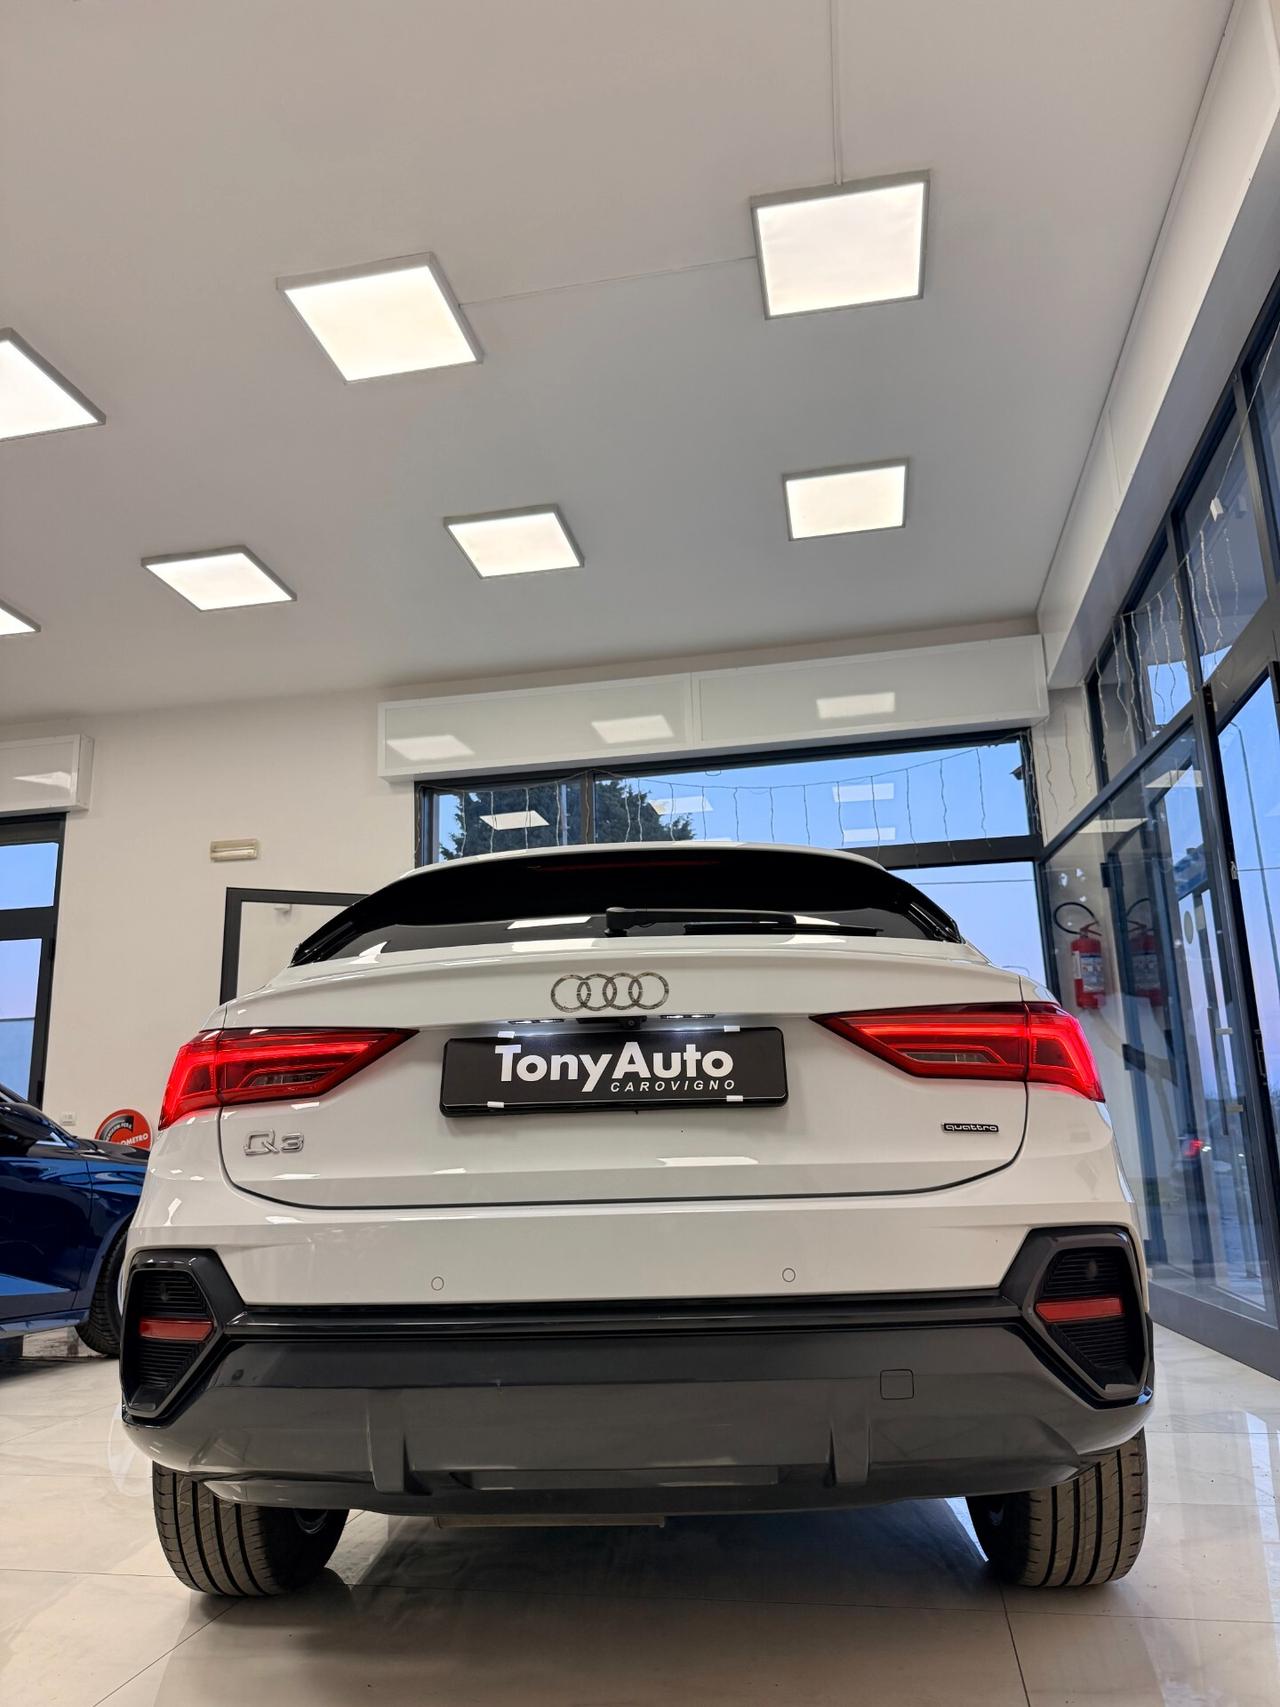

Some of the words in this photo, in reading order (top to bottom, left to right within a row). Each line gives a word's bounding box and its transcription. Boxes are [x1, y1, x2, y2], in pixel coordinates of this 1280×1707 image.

[495, 1041, 734, 1093] TonyAuto
[611, 1079, 735, 1092] CAROVIGNO
[944, 1124, 998, 1132] quattro
[120, 1133, 149, 1145] OMETRO
[243, 1128, 304, 1156] Q3
